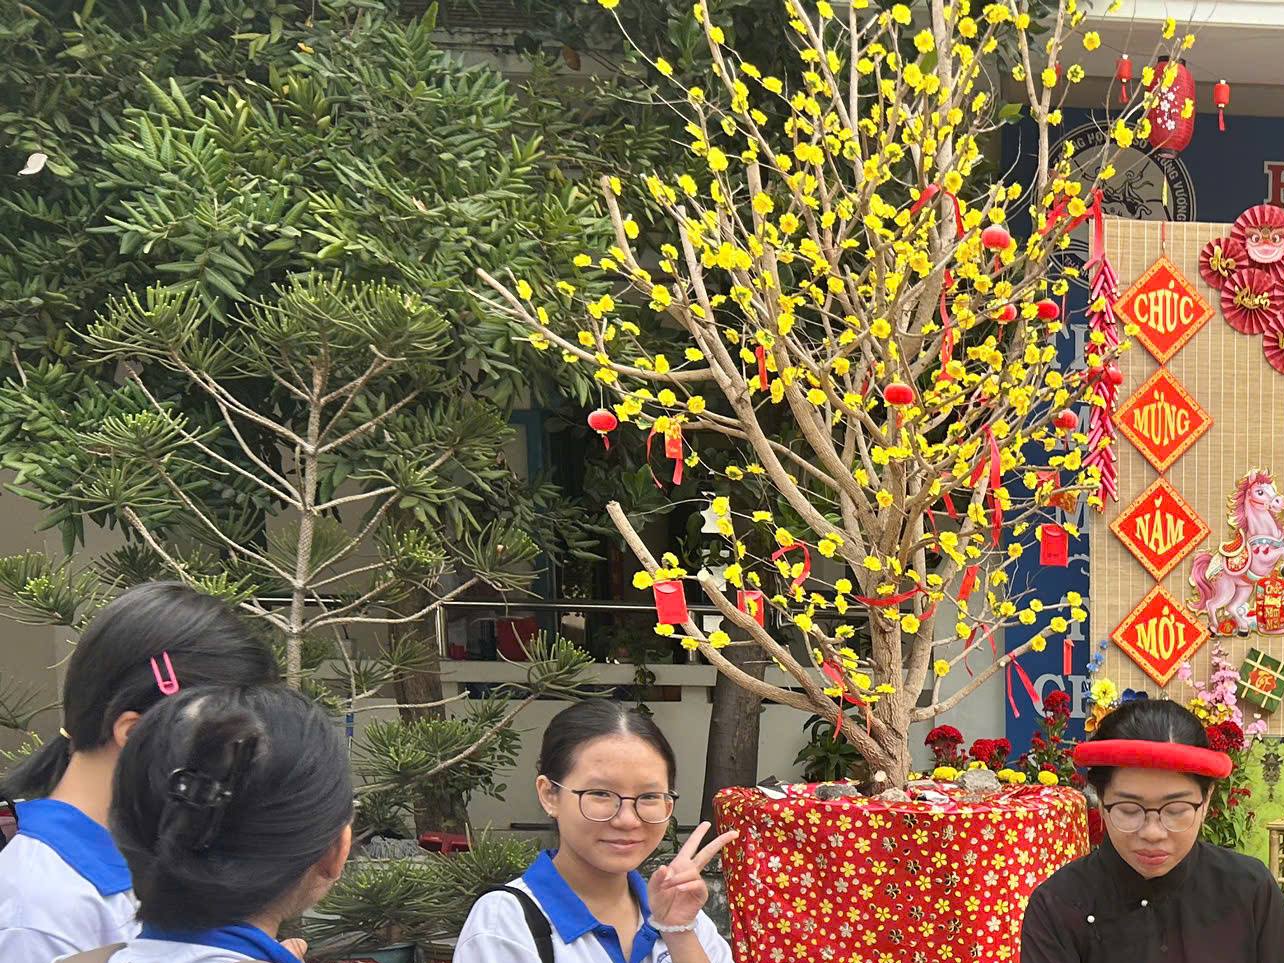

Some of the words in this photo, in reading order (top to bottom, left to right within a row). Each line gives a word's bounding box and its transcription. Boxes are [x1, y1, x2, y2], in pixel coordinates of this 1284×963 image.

[1133, 280, 1194, 334] CHÚC
[1133, 390, 1190, 446] MỪNG
[1135, 498, 1185, 555] NĂM
[1135, 606, 1186, 660] MỚI
